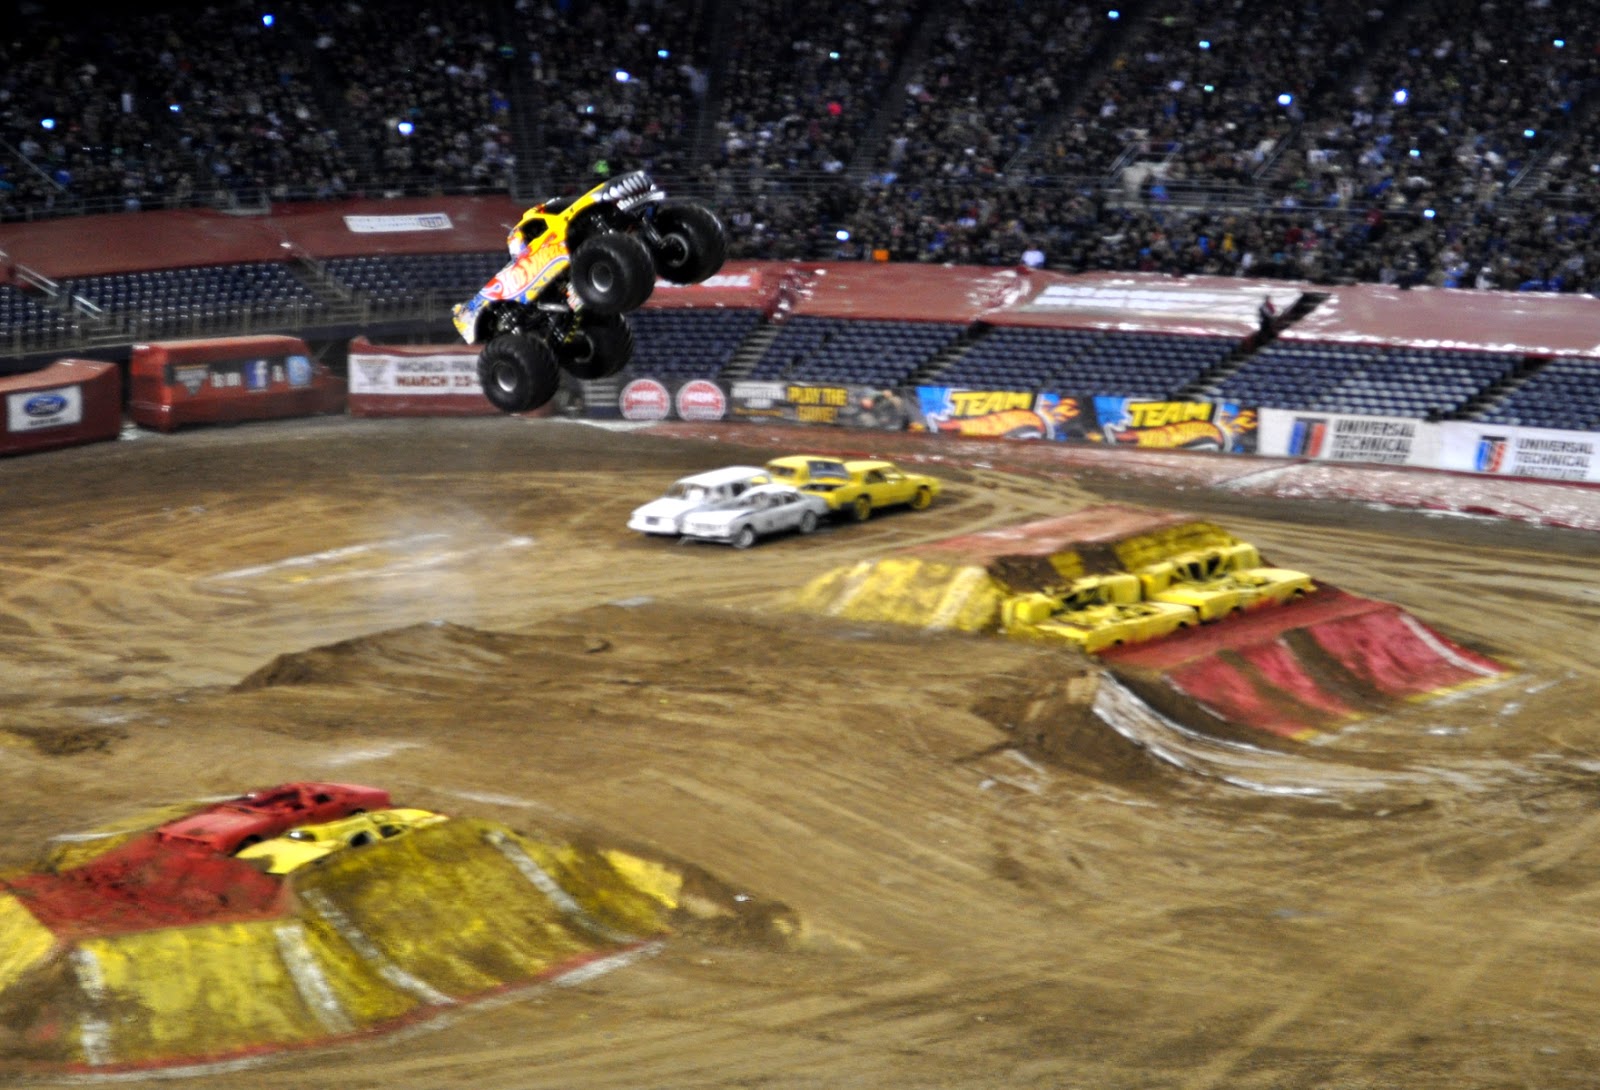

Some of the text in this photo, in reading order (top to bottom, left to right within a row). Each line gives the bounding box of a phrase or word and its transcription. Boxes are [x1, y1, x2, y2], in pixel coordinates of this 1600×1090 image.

[950, 391, 1033, 417] TEAM
[1128, 401, 1212, 427] TEAM
[1334, 419, 1416, 438] UNIVERSAL
[1332, 433, 1412, 453] TECHNICAL
[1516, 437, 1594, 455] UNIVERSAL
[1514, 450, 1591, 468] TECHNICAL
